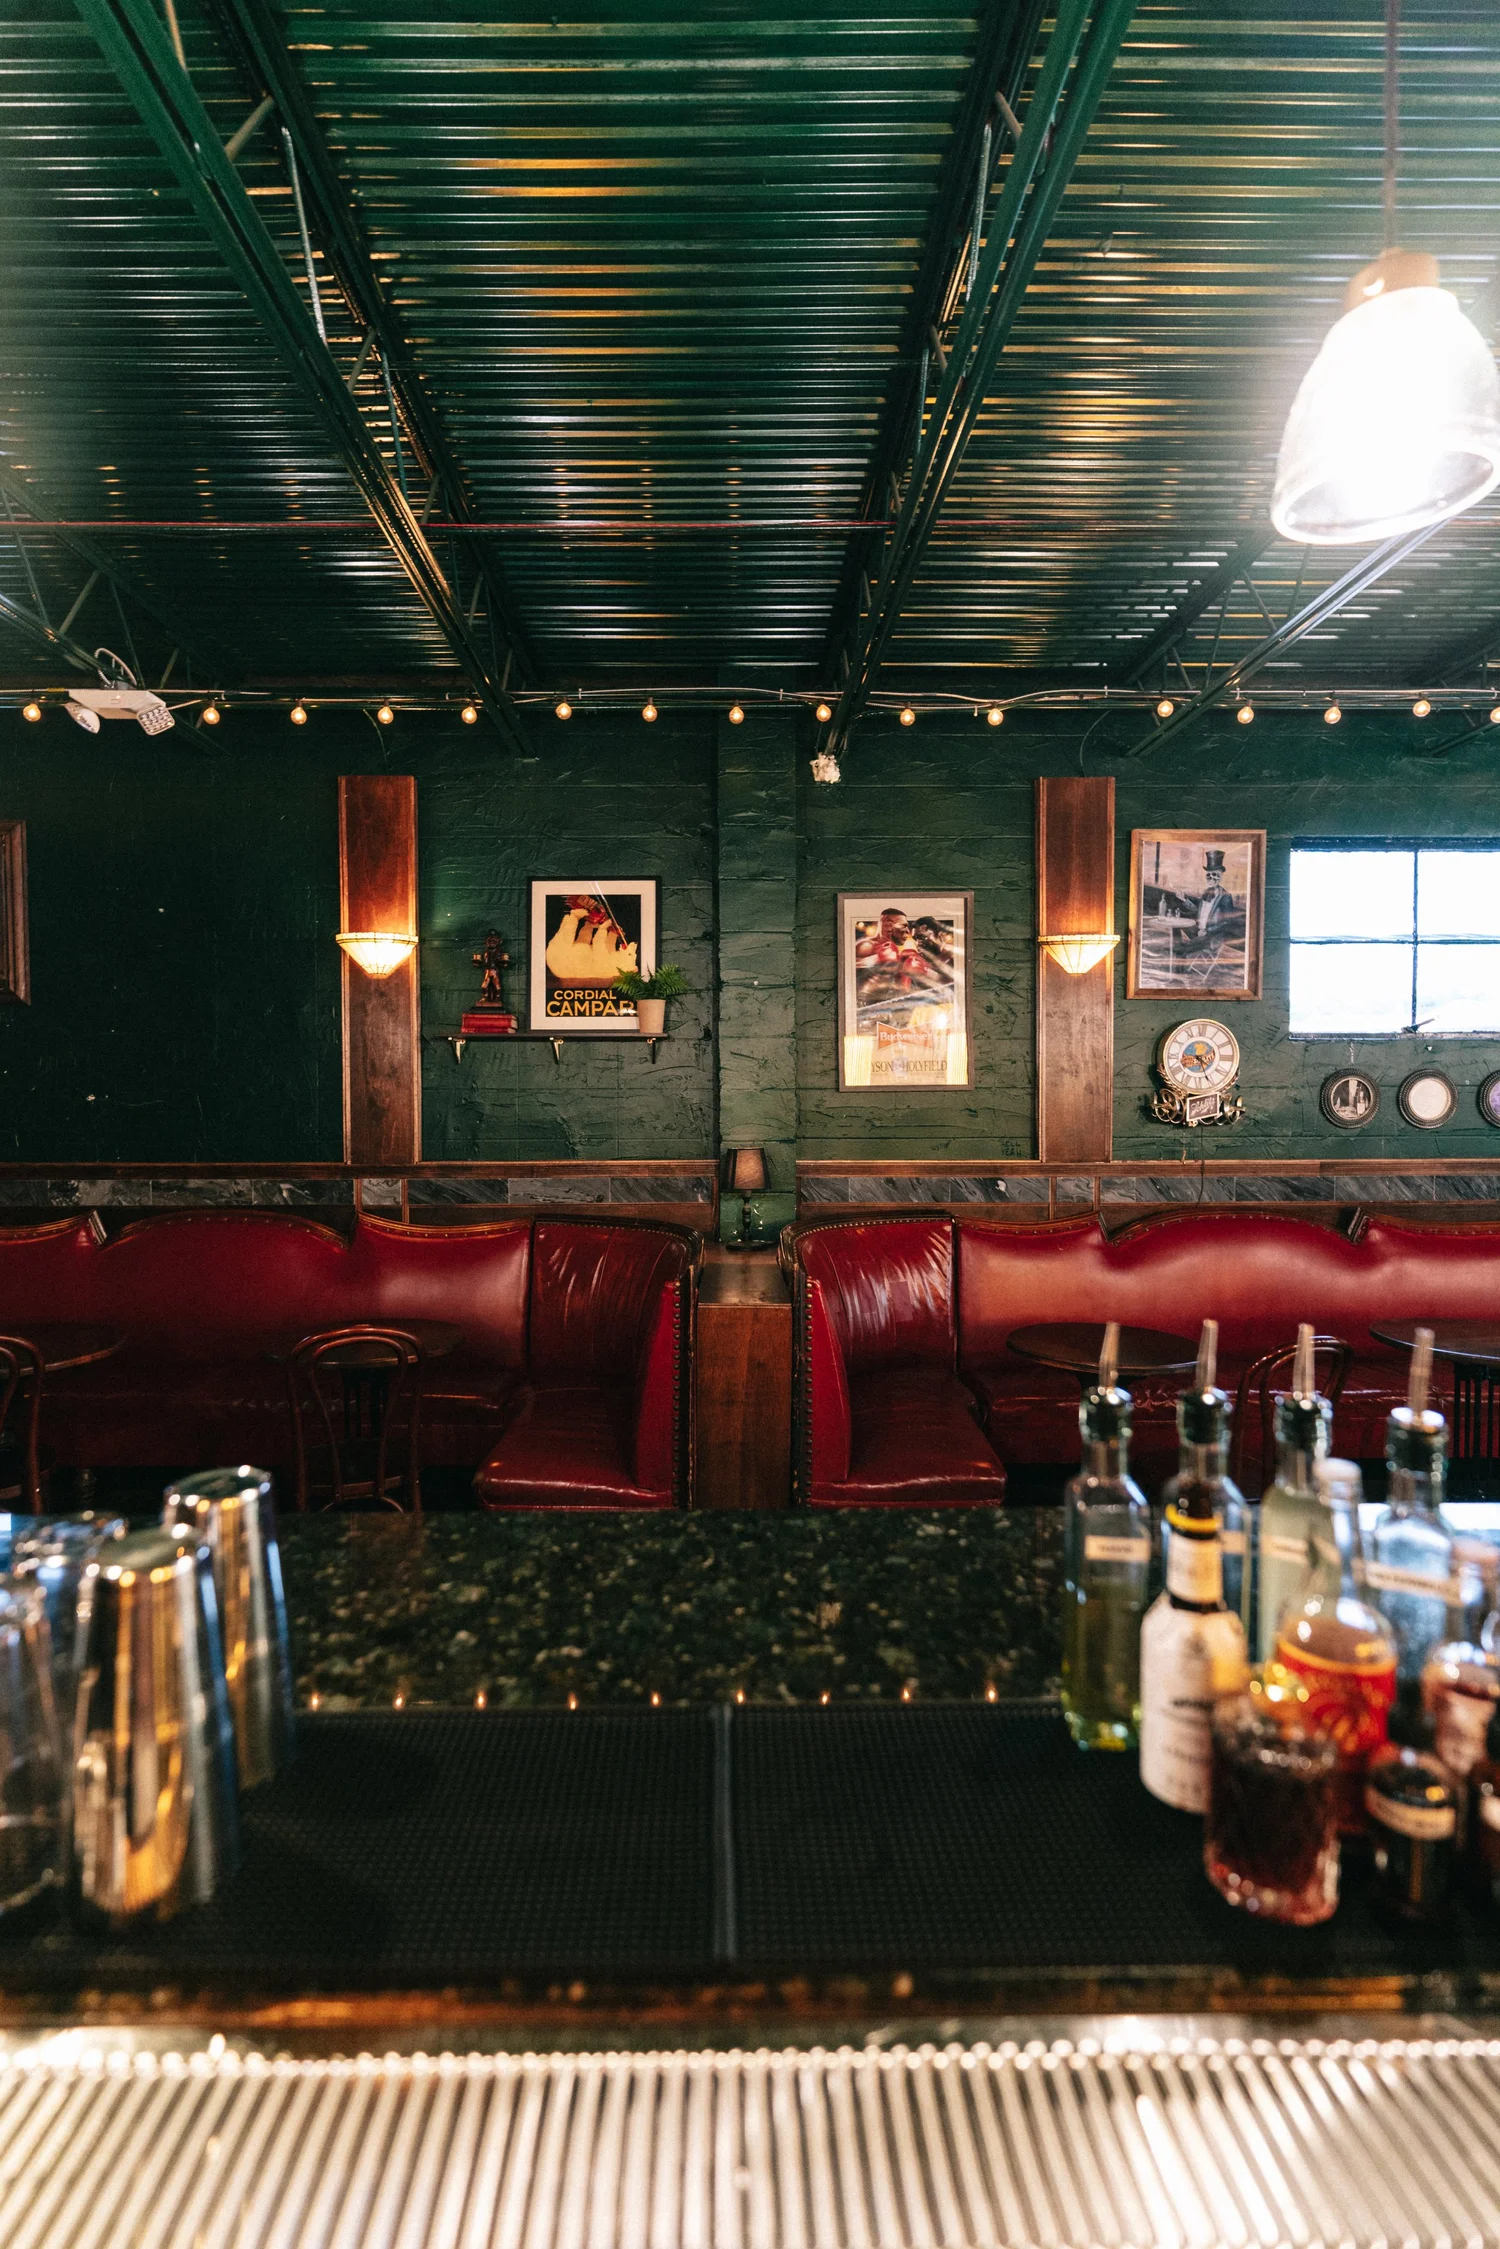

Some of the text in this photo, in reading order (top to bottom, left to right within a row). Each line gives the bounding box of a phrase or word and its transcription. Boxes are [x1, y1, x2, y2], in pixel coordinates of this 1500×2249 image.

[553, 989, 617, 1000] CORDIAL
[546, 1000, 635, 1017] CAMPAR
[879, 1031, 933, 1041] Budweiser
[870, 1060, 948, 1073] YSON HOLYFIELD
